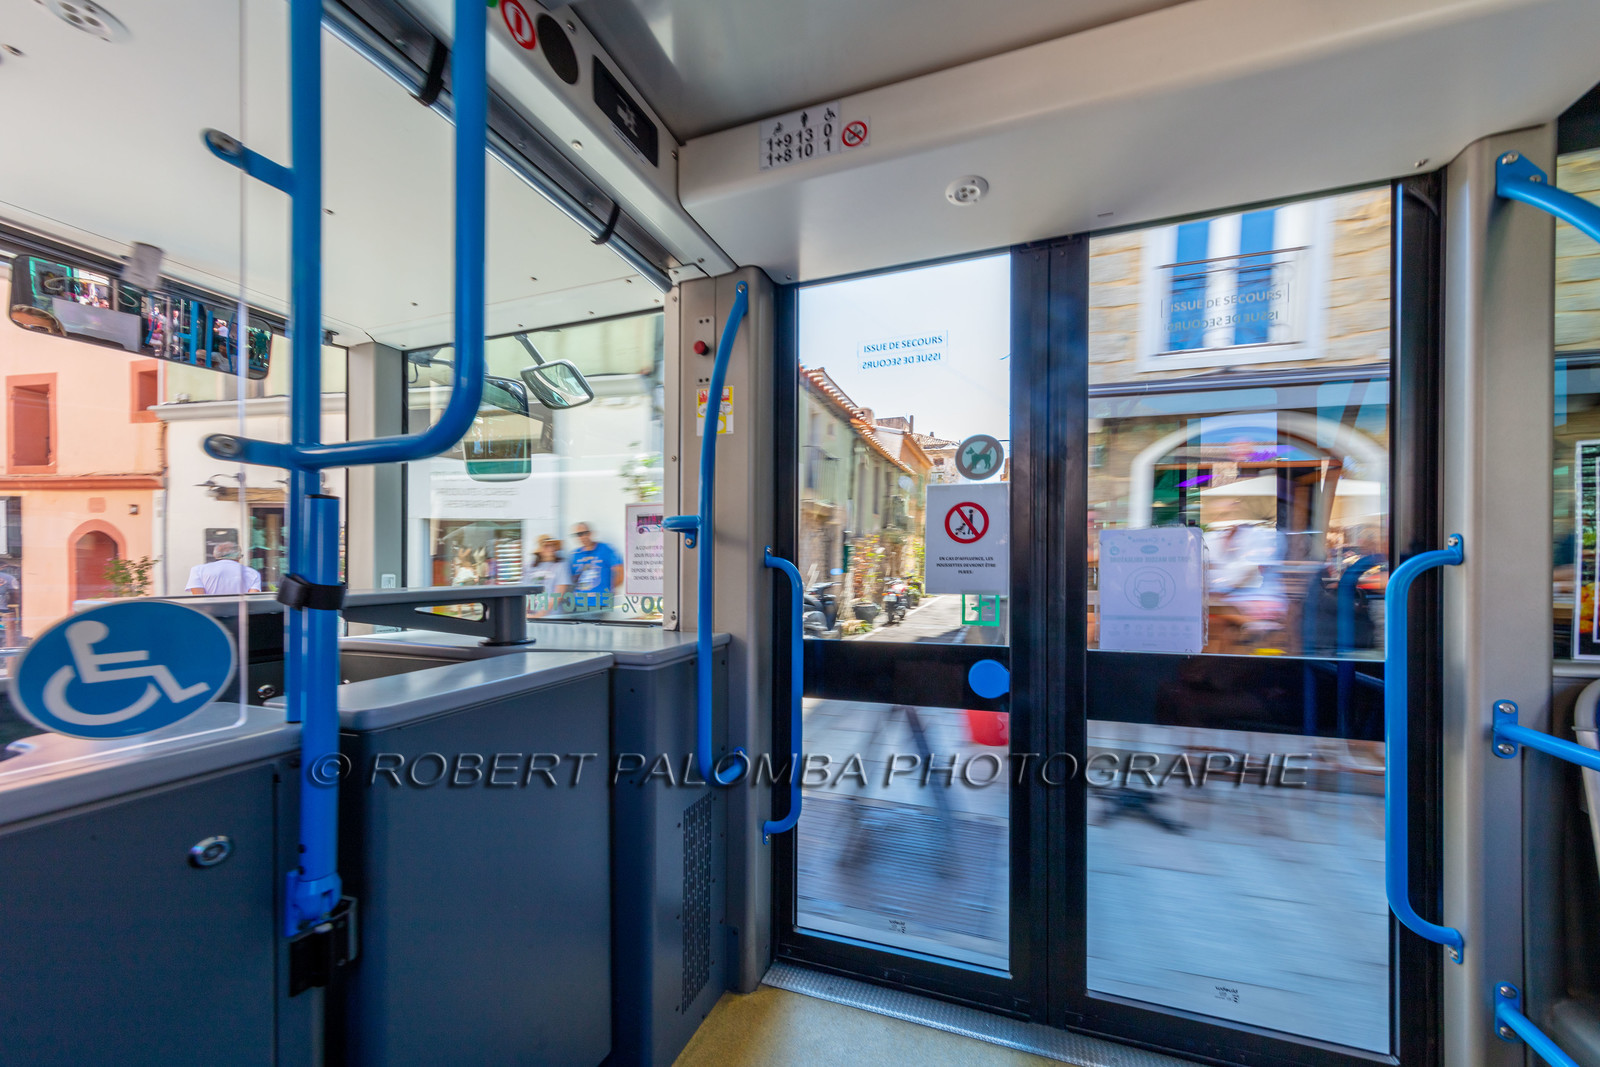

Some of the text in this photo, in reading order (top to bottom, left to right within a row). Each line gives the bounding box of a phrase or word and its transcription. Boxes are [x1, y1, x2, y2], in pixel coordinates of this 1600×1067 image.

[766, 122, 833, 152] 1+9 13 0
[766, 138, 832, 167] 1+8 10 1
[1170, 290, 1283, 313] ISSUE DE SECOURS
[863, 335, 943, 353] ISSUE DE SECOURS
